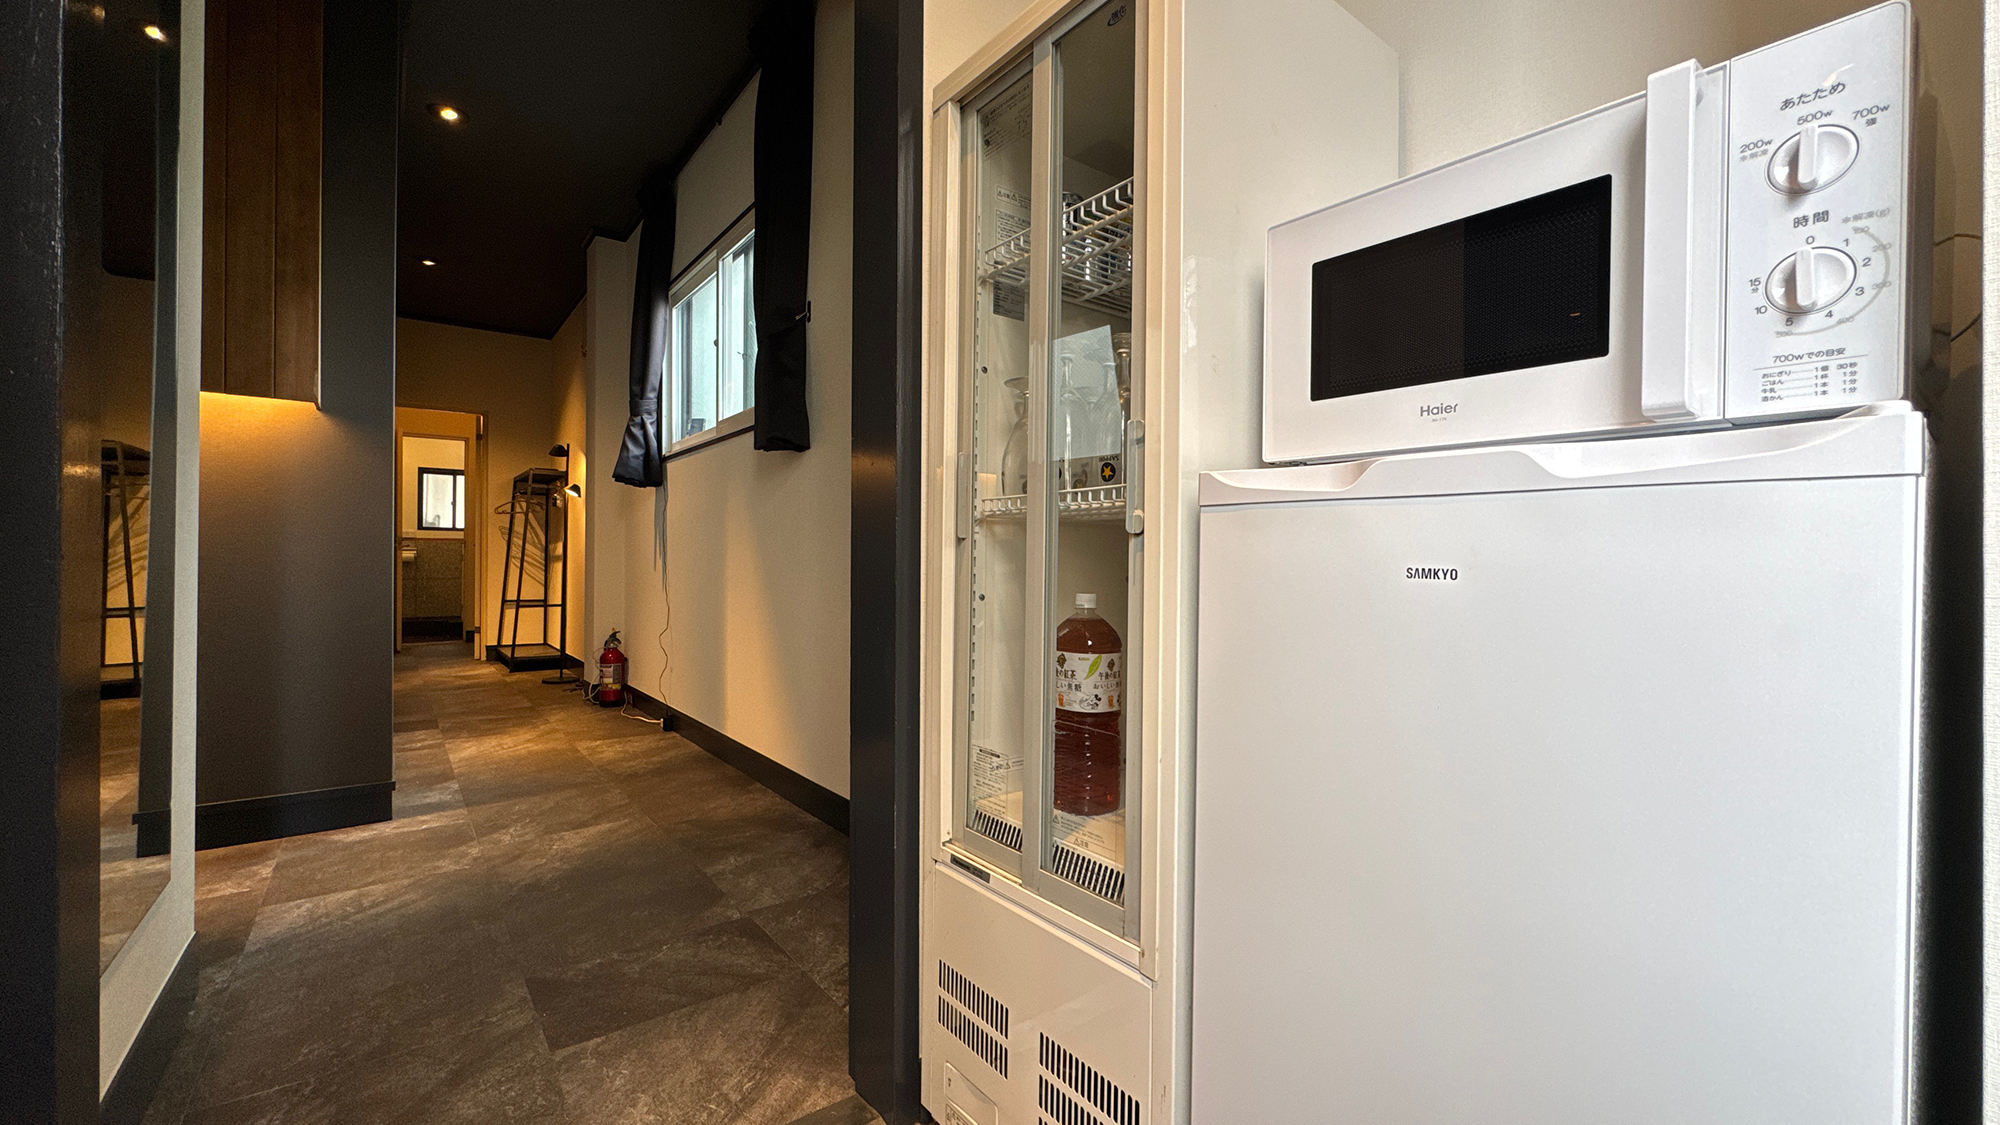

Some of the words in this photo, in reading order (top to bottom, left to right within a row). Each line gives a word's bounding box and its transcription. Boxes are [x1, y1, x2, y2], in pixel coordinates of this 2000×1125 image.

[1780, 82, 1846, 111] あたため
[1793, 210, 1829, 229] 時間
[1805, 235, 1815, 245] 0
[1843, 238, 1849, 247] 1
[1862, 257, 1871, 267] 2
[1749, 277, 1761, 287] 15
[1855, 286, 1865, 296] 3
[1754, 305, 1768, 315] 10
[1825, 310, 1833, 318] 4
[1785, 317, 1794, 327] 5
[1762, 370, 1791, 379] おにぎり
[1420, 402, 1458, 417] Haier
[1406, 567, 1458, 580] SAMKYO
